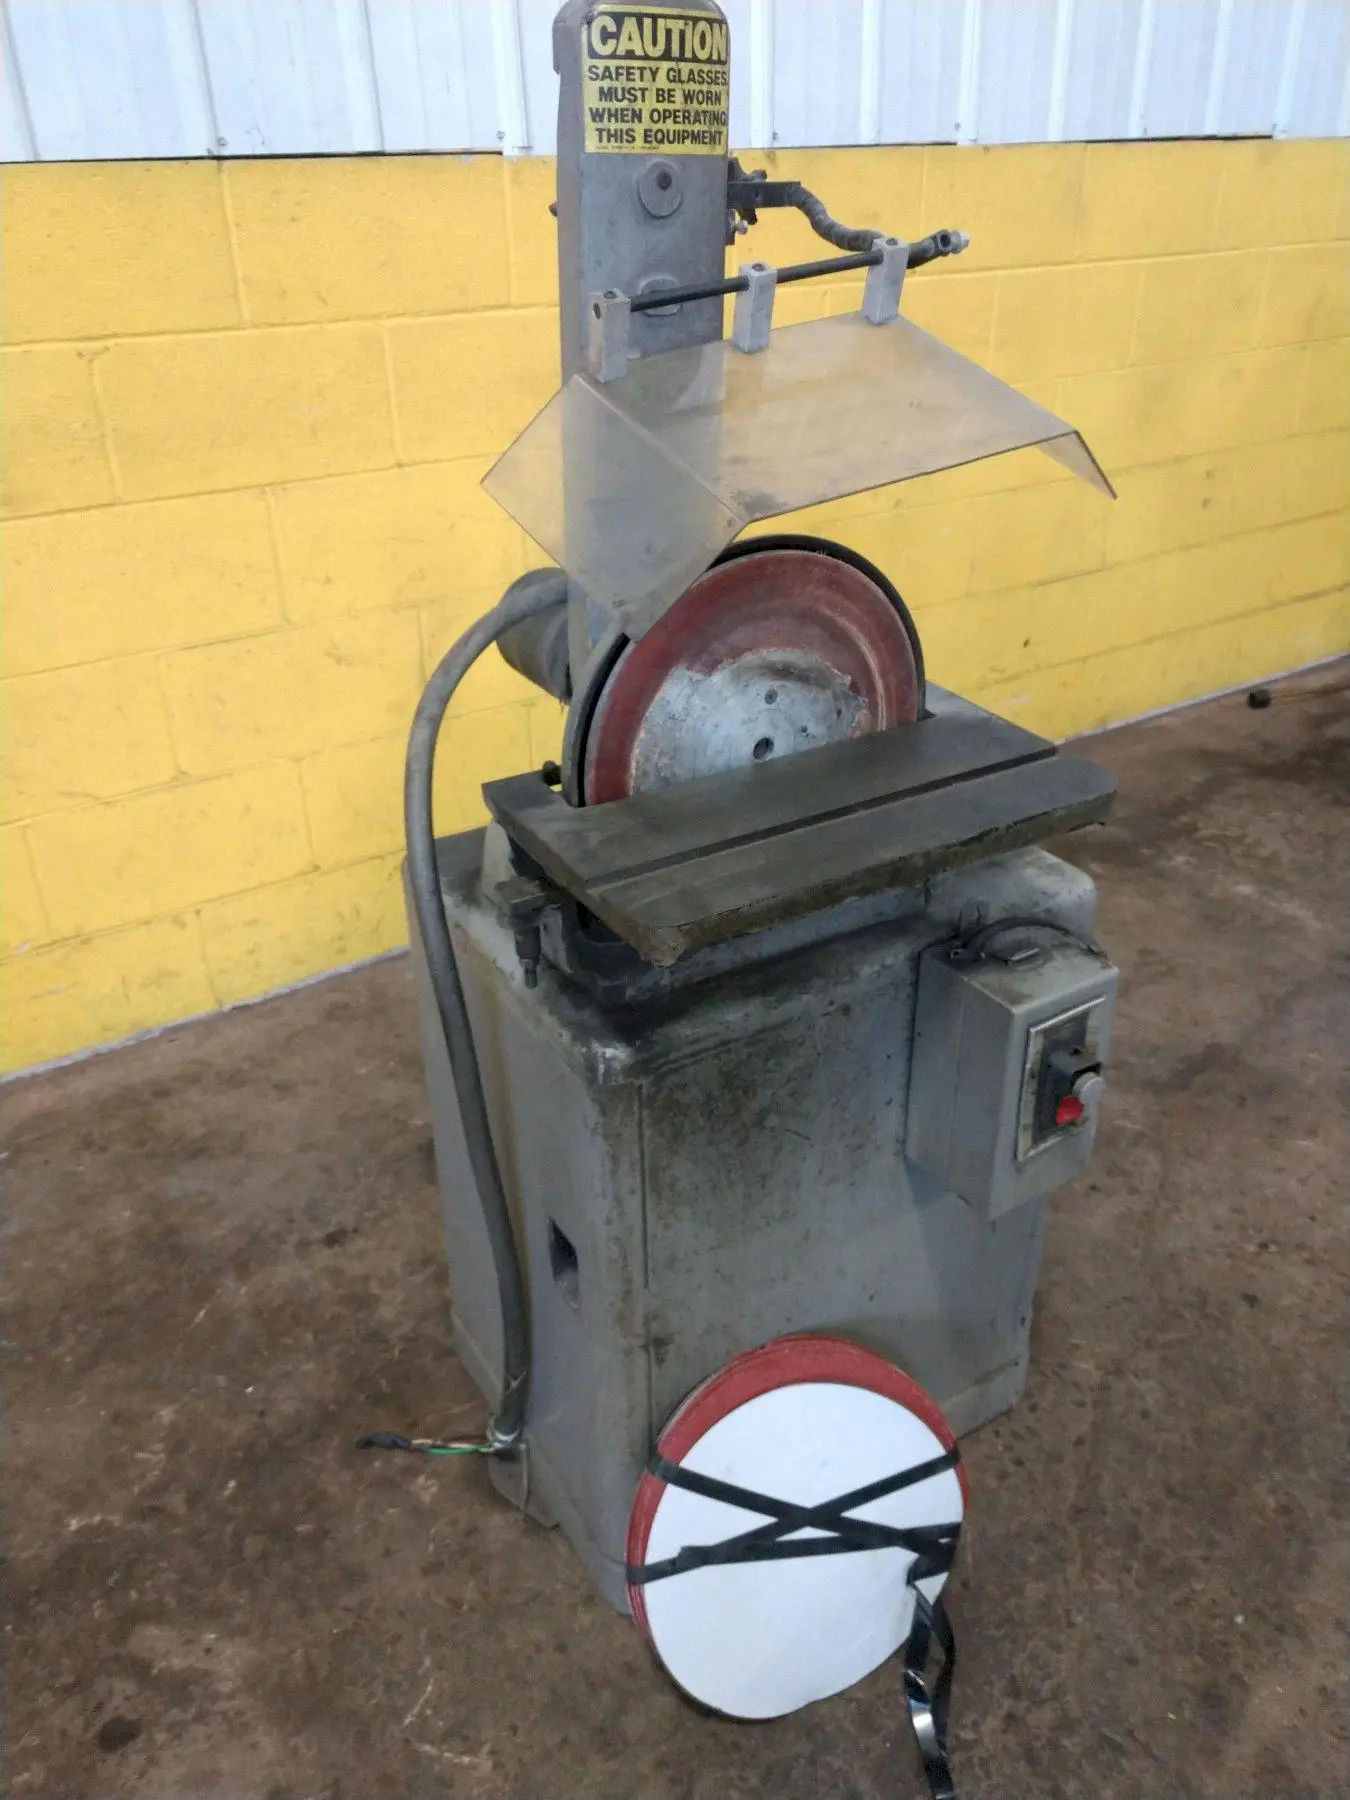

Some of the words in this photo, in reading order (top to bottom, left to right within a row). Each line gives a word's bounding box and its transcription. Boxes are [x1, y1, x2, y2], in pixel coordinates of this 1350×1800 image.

[591, 15, 727, 61] CAUTION
[588, 65, 659, 82] SAFETY
[666, 68, 727, 86] GLASSES
[598, 87, 648, 103] MUST
[656, 88, 676, 104] BE
[682, 89, 721, 105] WORN
[589, 107, 642, 123] WHEN
[650, 108, 727, 126] OPERATING
[595, 128, 636, 144] THIS
[644, 129, 723, 145] EQUIPMENT
